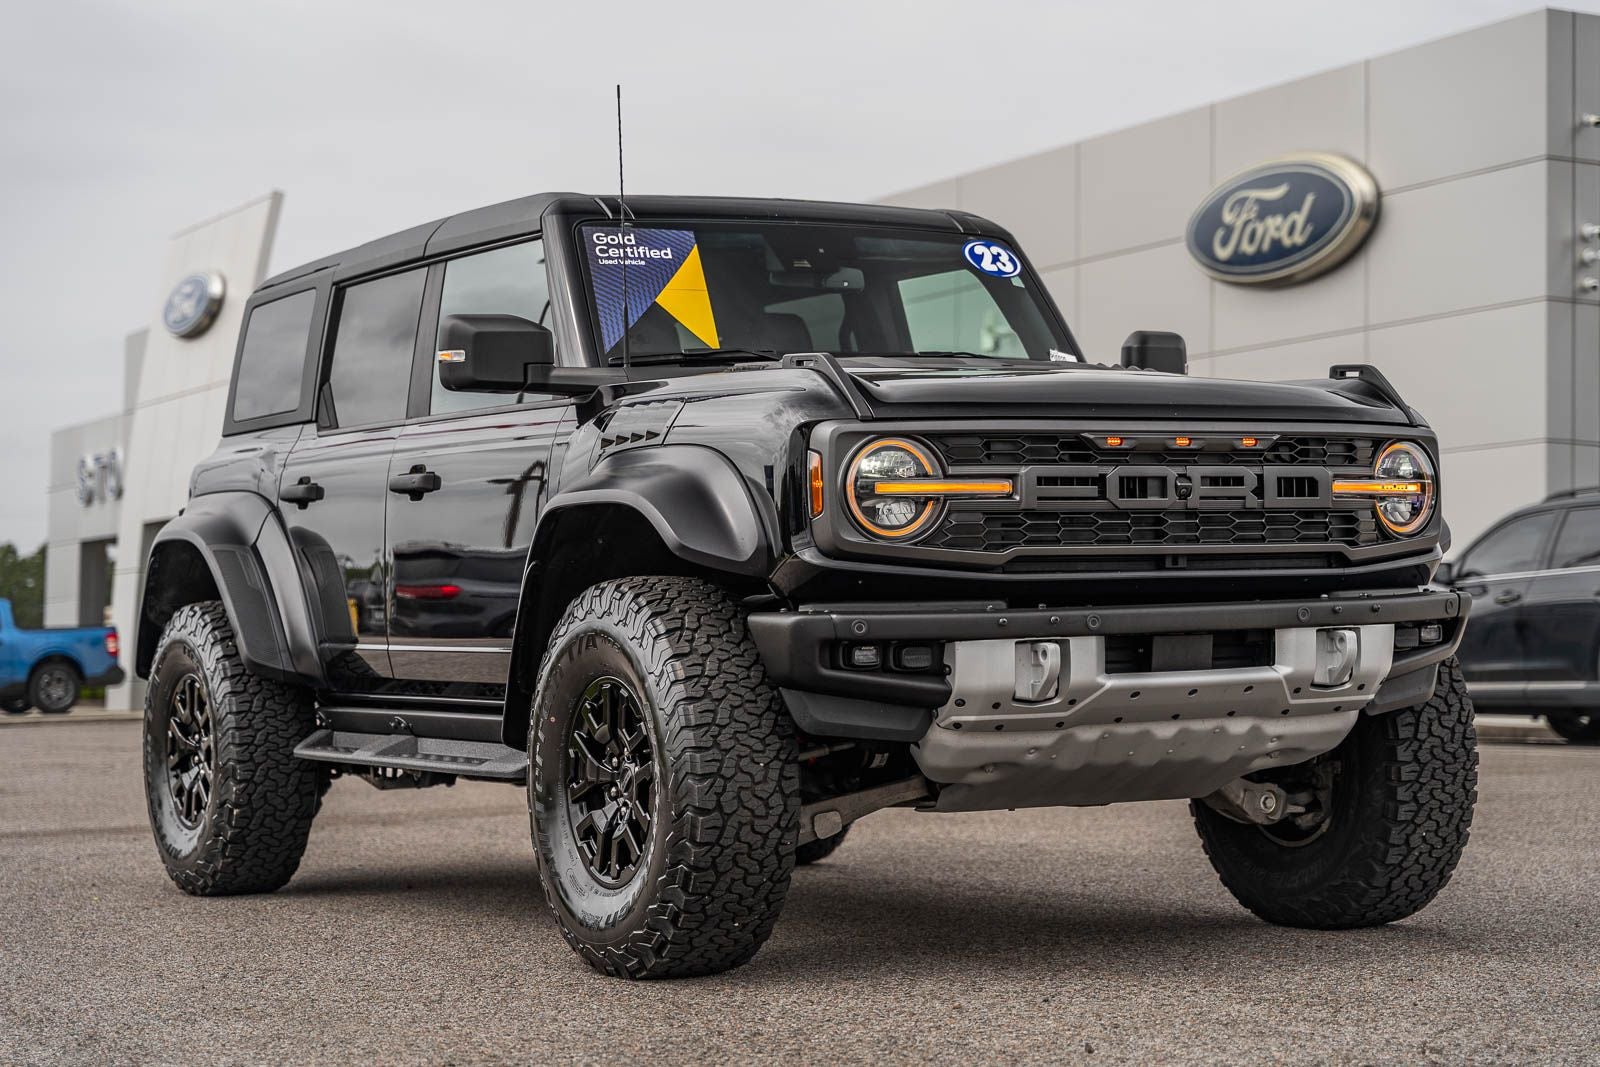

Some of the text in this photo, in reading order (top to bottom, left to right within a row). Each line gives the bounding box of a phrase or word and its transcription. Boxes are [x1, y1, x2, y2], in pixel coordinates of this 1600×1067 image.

[1213, 182, 1316, 262] Ford
[592, 233, 636, 245] Gold
[595, 245, 673, 259] Certified
[973, 244, 1015, 273] 23
[1021, 465, 1332, 510] FORD
